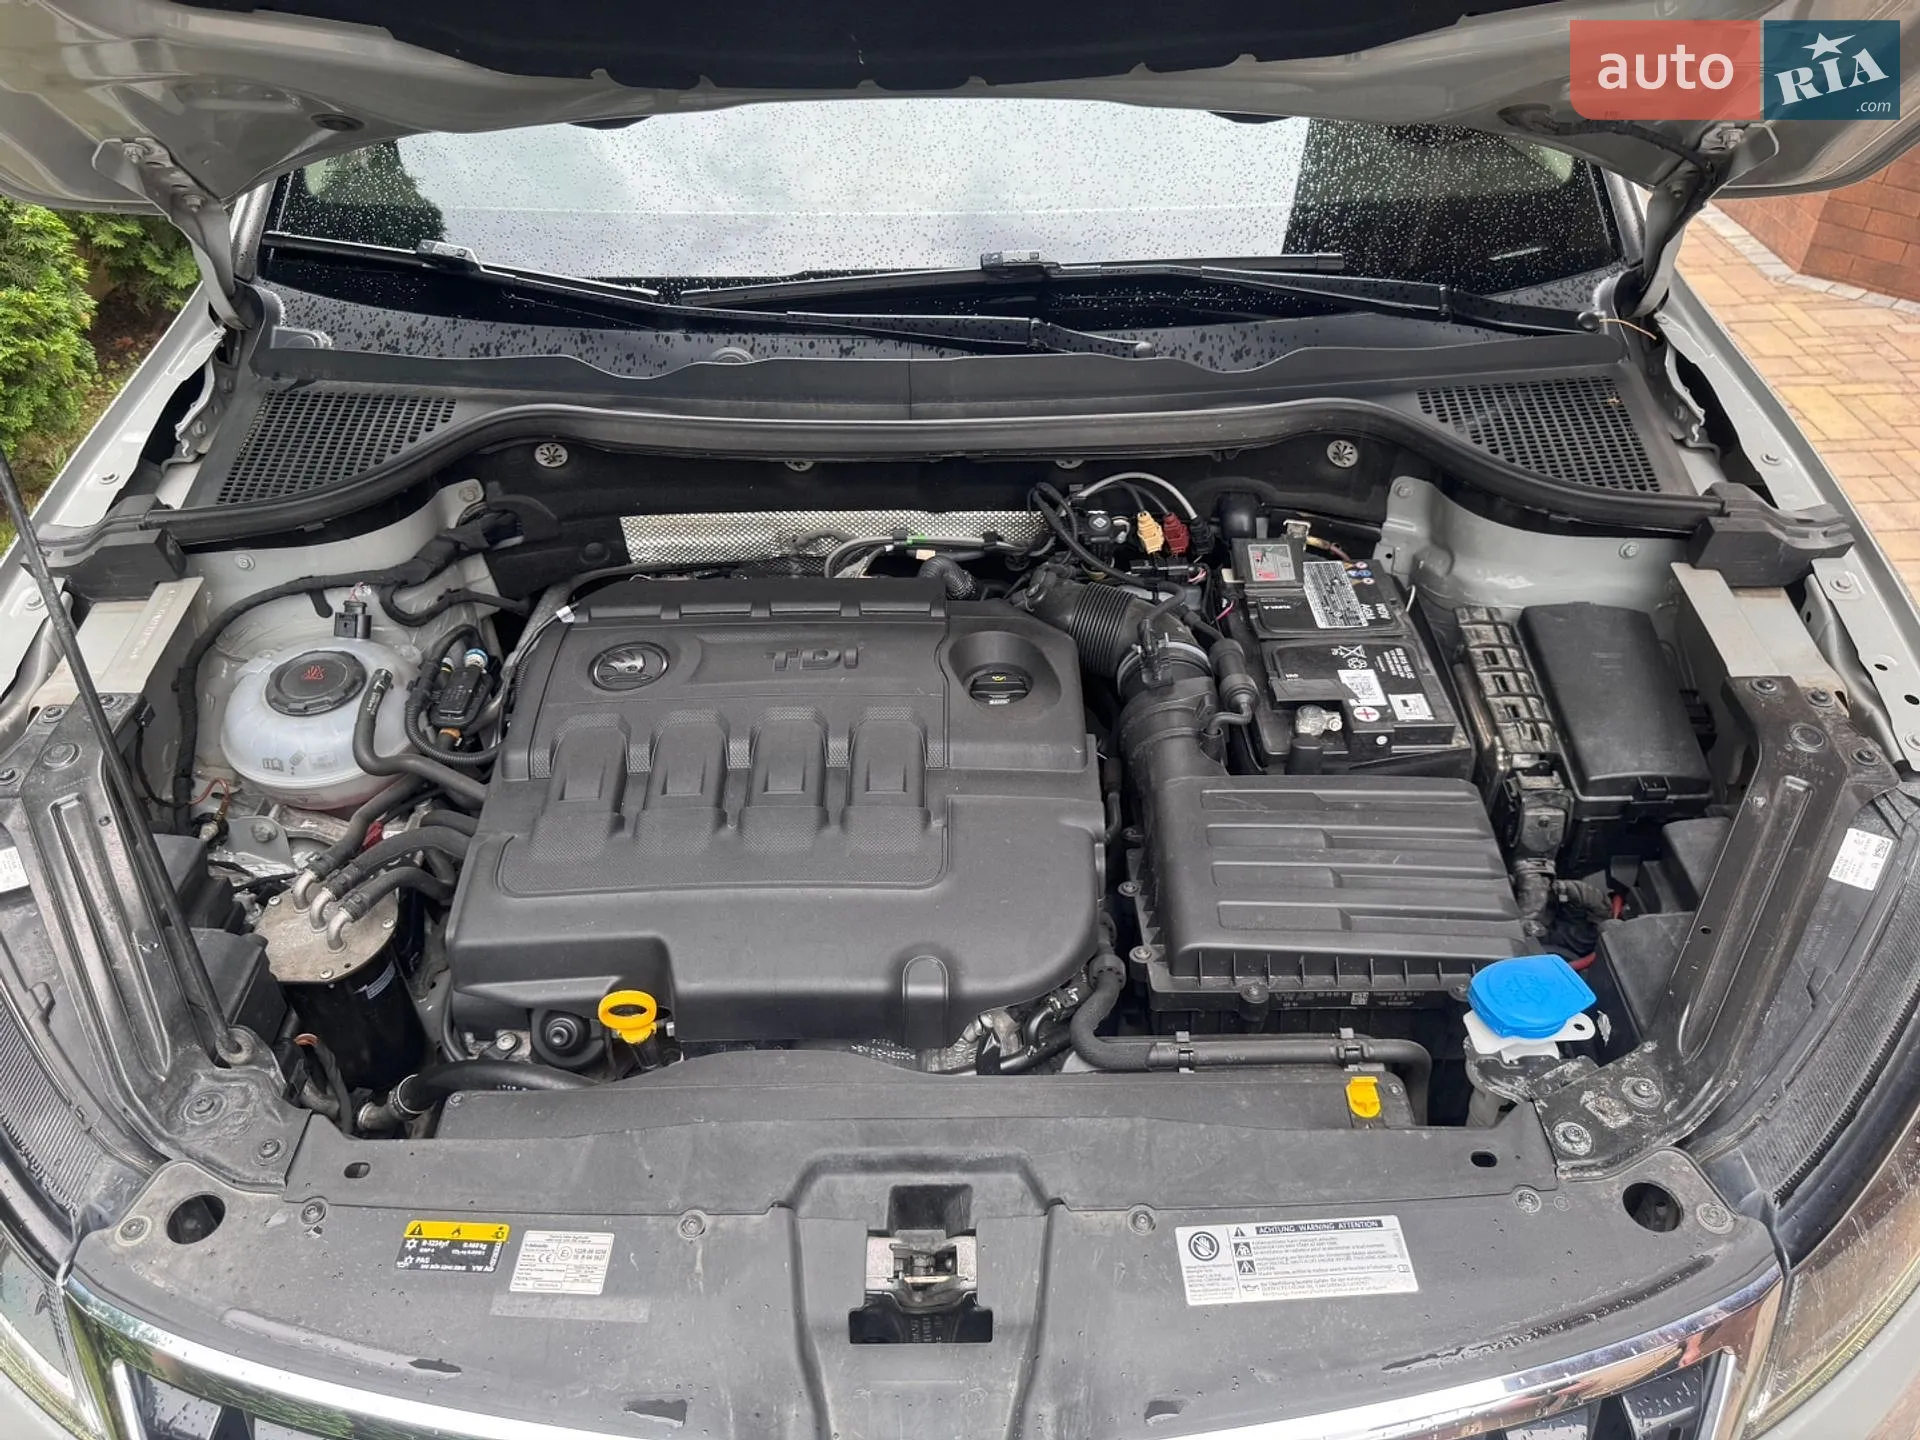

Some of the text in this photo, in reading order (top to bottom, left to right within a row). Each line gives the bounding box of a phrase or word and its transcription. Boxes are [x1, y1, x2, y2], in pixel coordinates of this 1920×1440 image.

[763, 648, 859, 673] TDI
[1259, 1220, 1379, 1234] ACHTUNG WARNING ATTENTION
